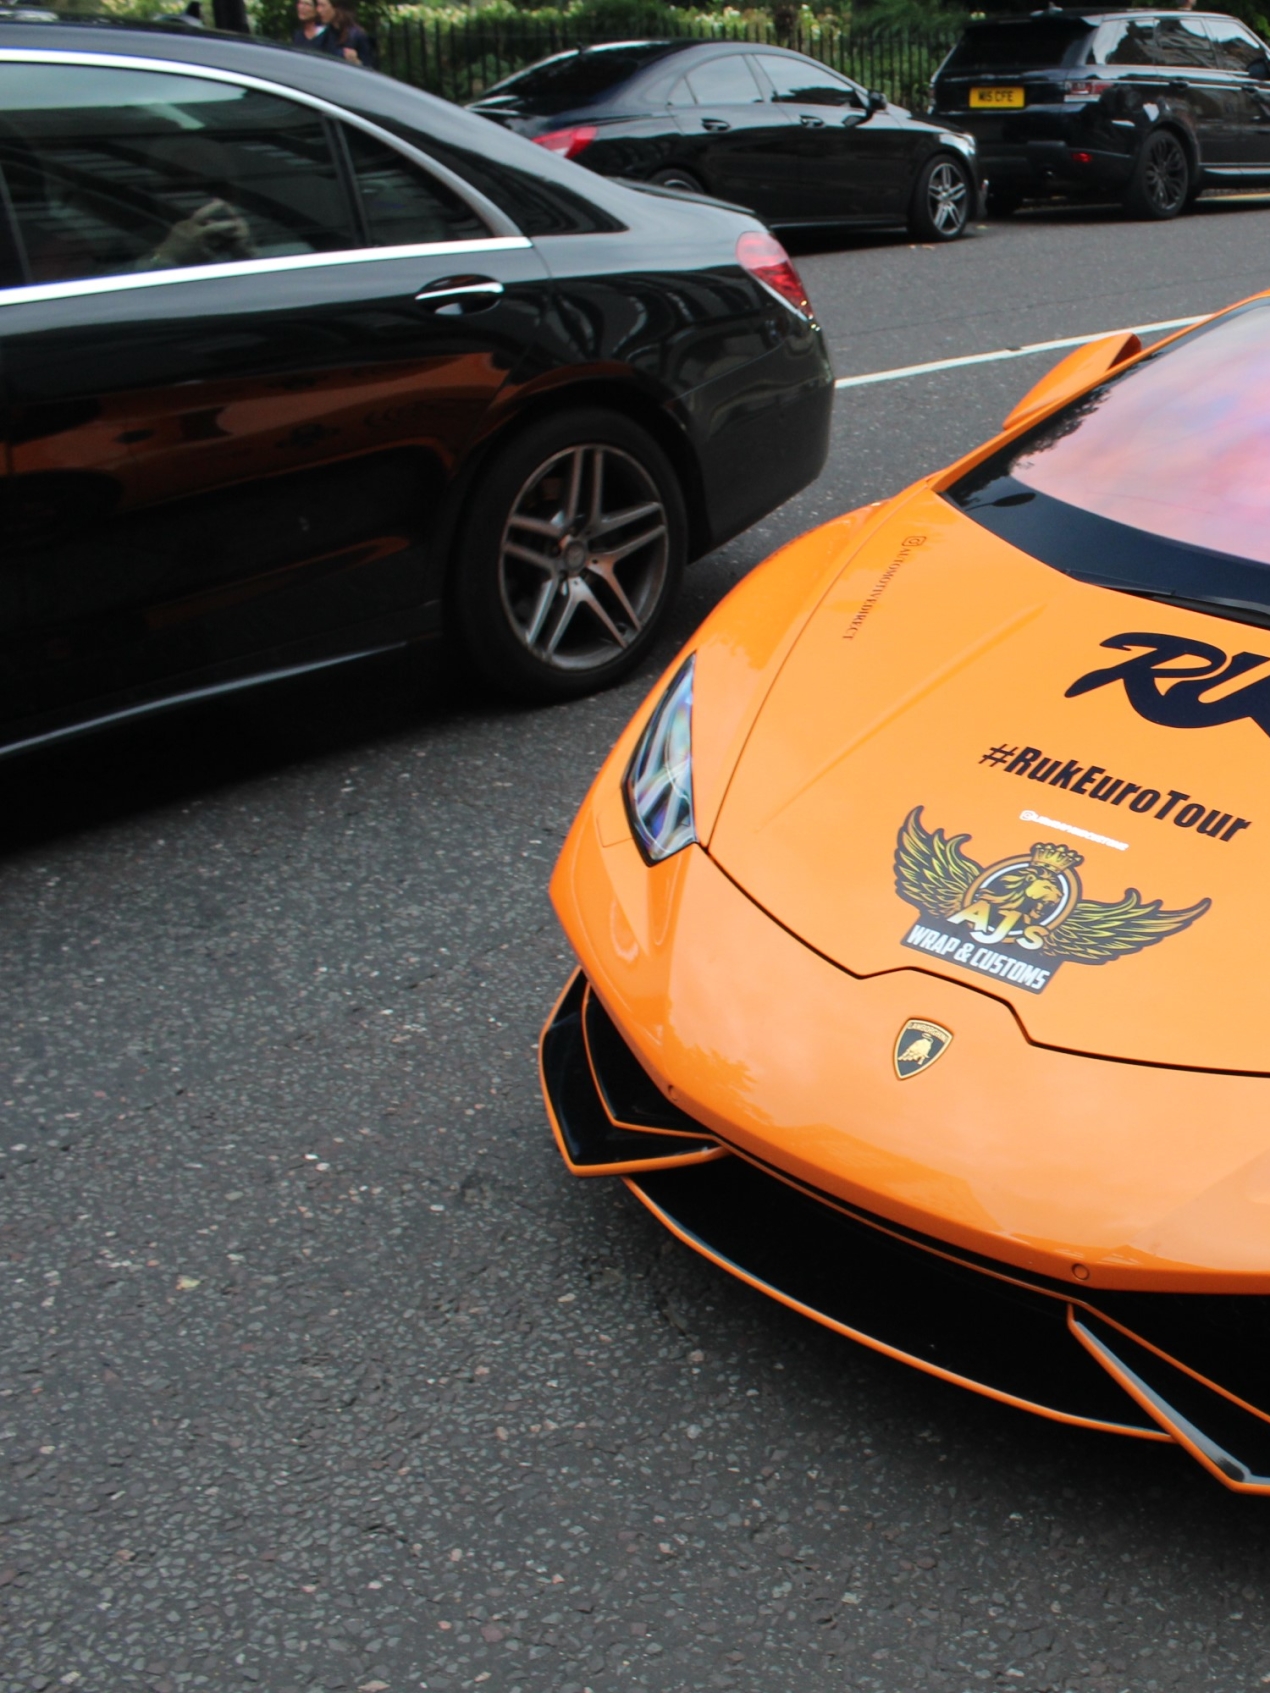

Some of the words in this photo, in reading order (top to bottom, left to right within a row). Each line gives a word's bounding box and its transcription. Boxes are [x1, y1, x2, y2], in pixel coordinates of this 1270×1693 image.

[977, 743, 1253, 842] #RukEuroTour
[906, 924, 961, 956] WRAP
[953, 943, 976, 964] &
[969, 947, 1051, 990] CUSTOMS
